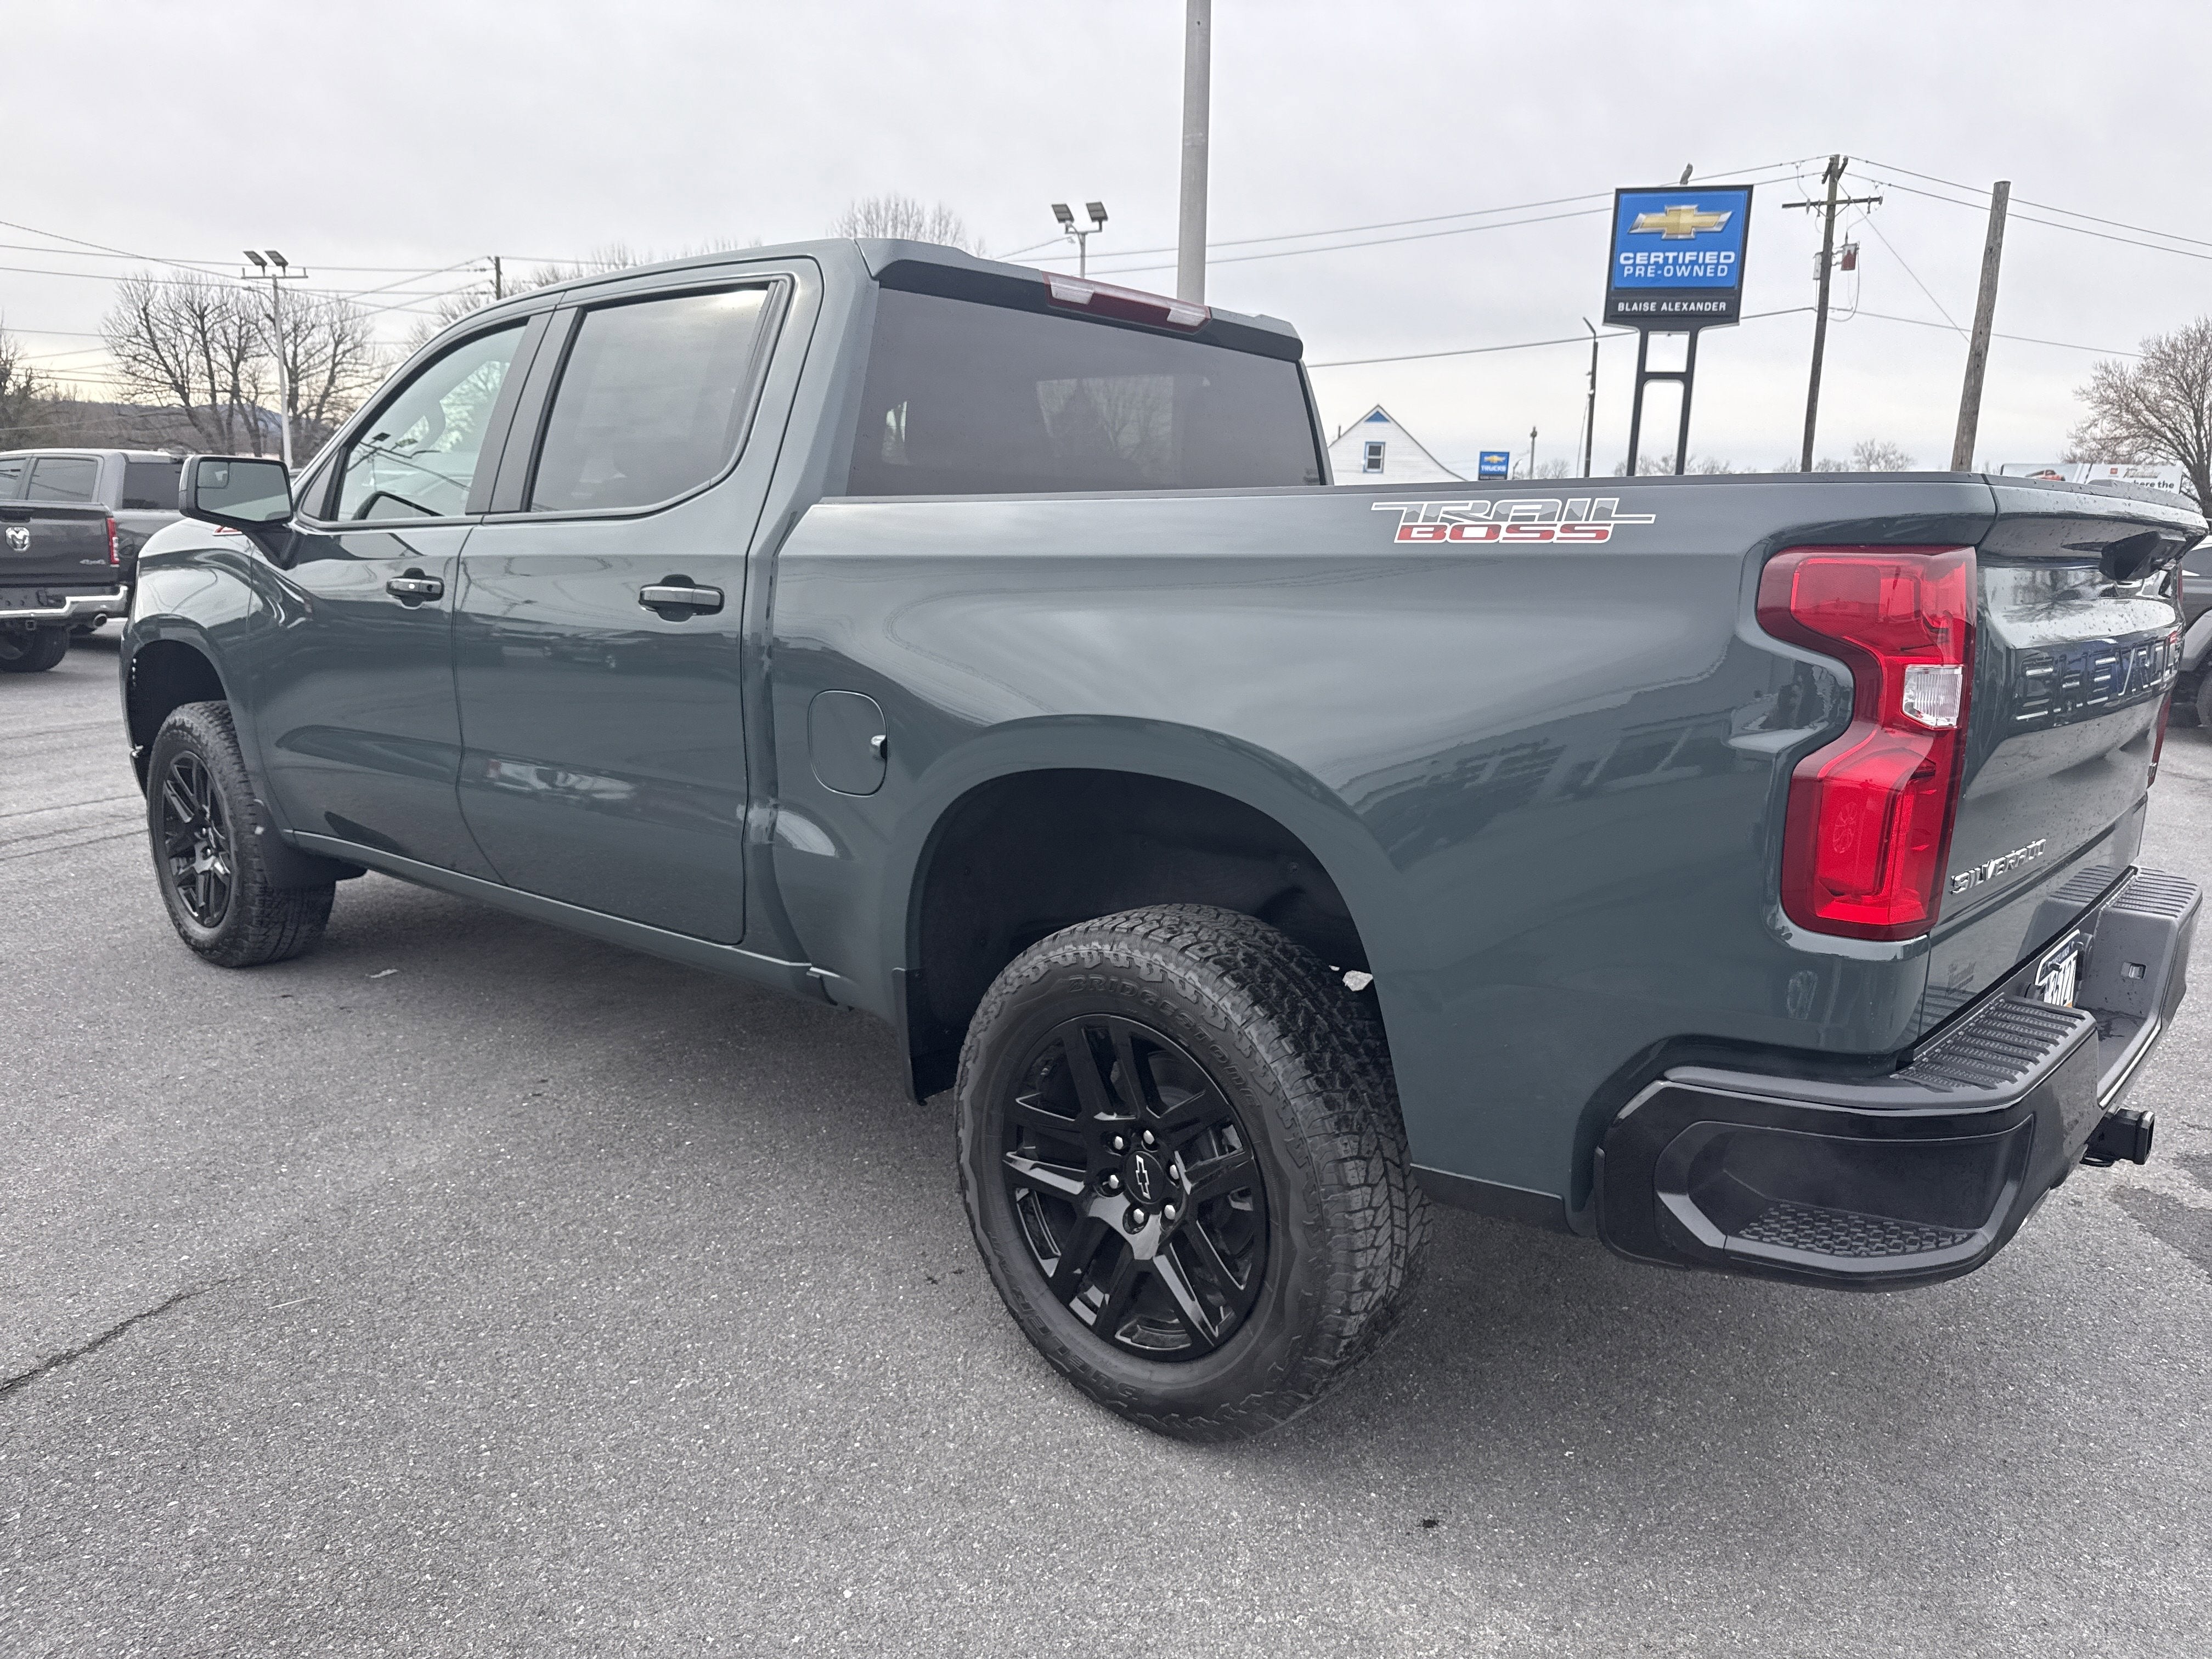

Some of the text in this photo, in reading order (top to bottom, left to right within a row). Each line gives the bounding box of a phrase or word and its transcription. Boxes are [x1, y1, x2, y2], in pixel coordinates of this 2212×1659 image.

[1620, 251, 1735, 264] CERTIFIED
[1623, 264, 1728, 278] PRE-OWNED
[1618, 301, 1726, 312] BLAISE ALEXANDER
[2158, 480, 2174, 488] the
[1371, 498, 1656, 524] TRAIL
[1393, 522, 1615, 543] BOSS
[1950, 838, 2046, 894] SILVERADO
[1068, 974, 1261, 1107] BRIDGESTONE
